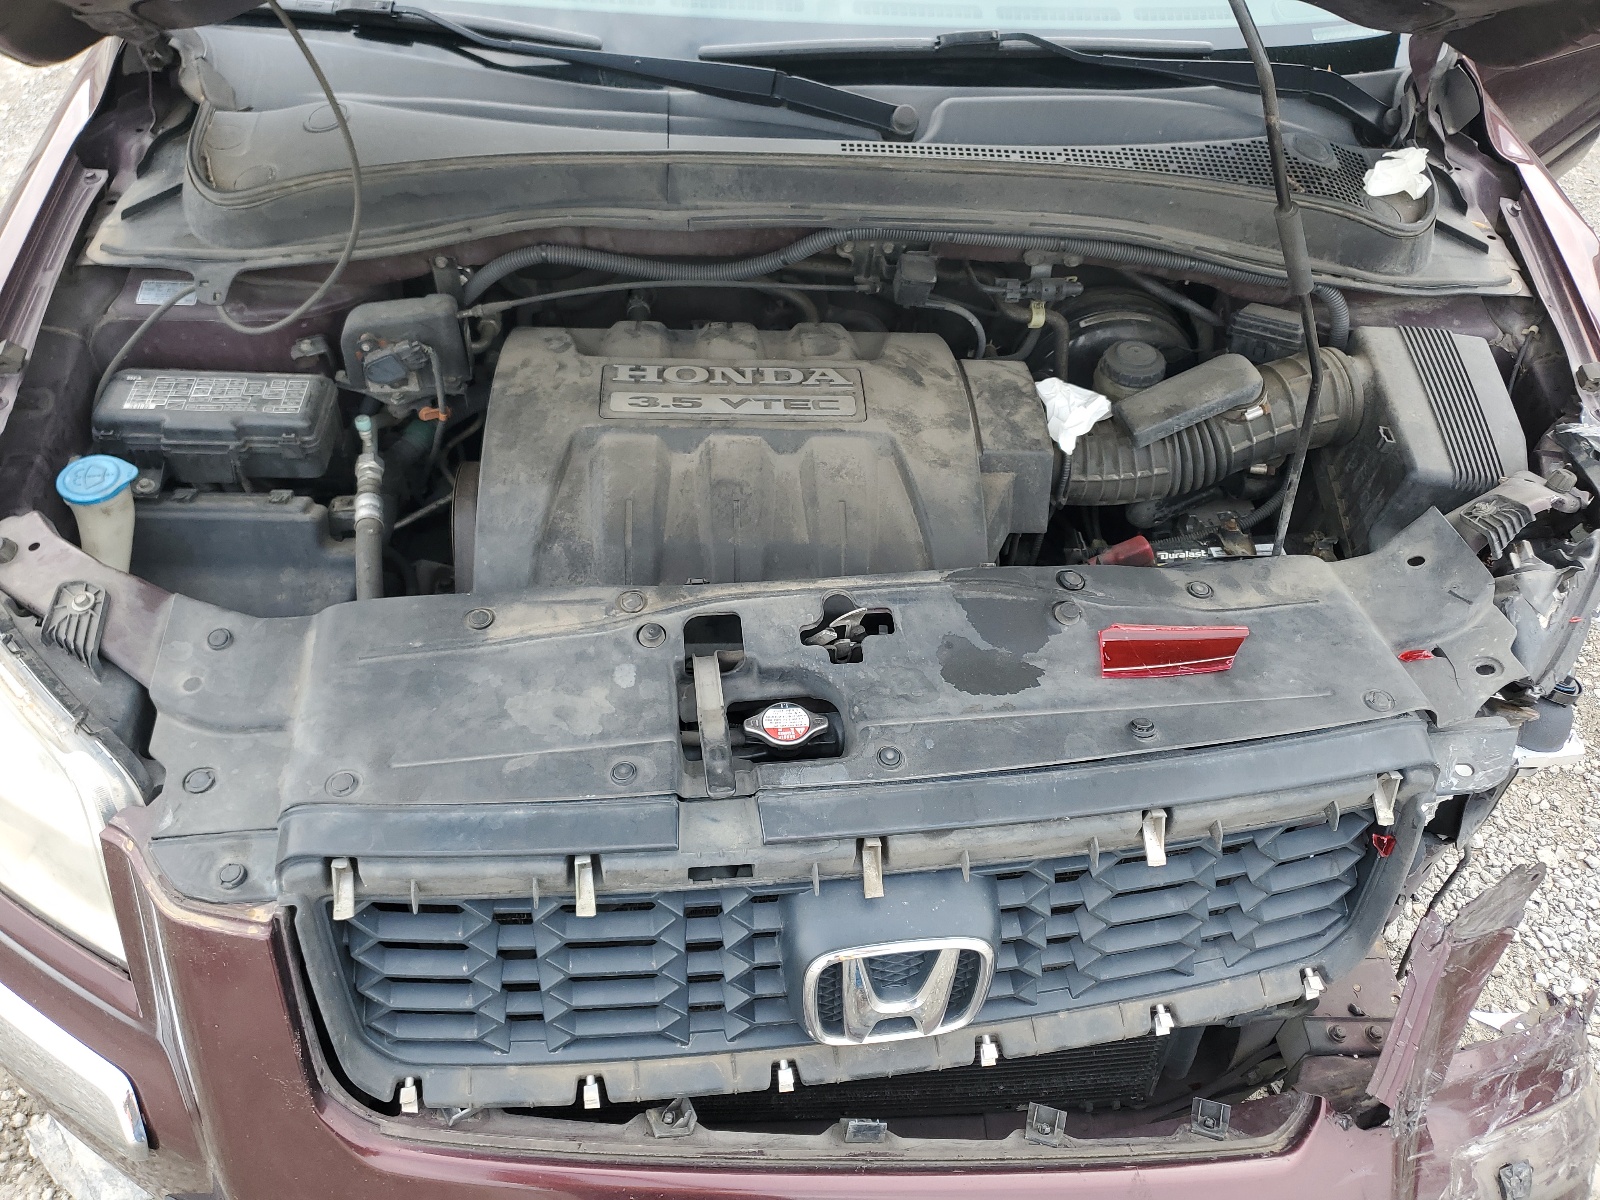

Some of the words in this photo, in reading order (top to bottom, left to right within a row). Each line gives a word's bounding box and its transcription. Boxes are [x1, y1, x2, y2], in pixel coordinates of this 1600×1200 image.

[612, 364, 854, 388] HONDA
[627, 396, 703, 409] 3.5
[719, 397, 841, 411] VTEC
[1158, 549, 1207, 560] Duralast
